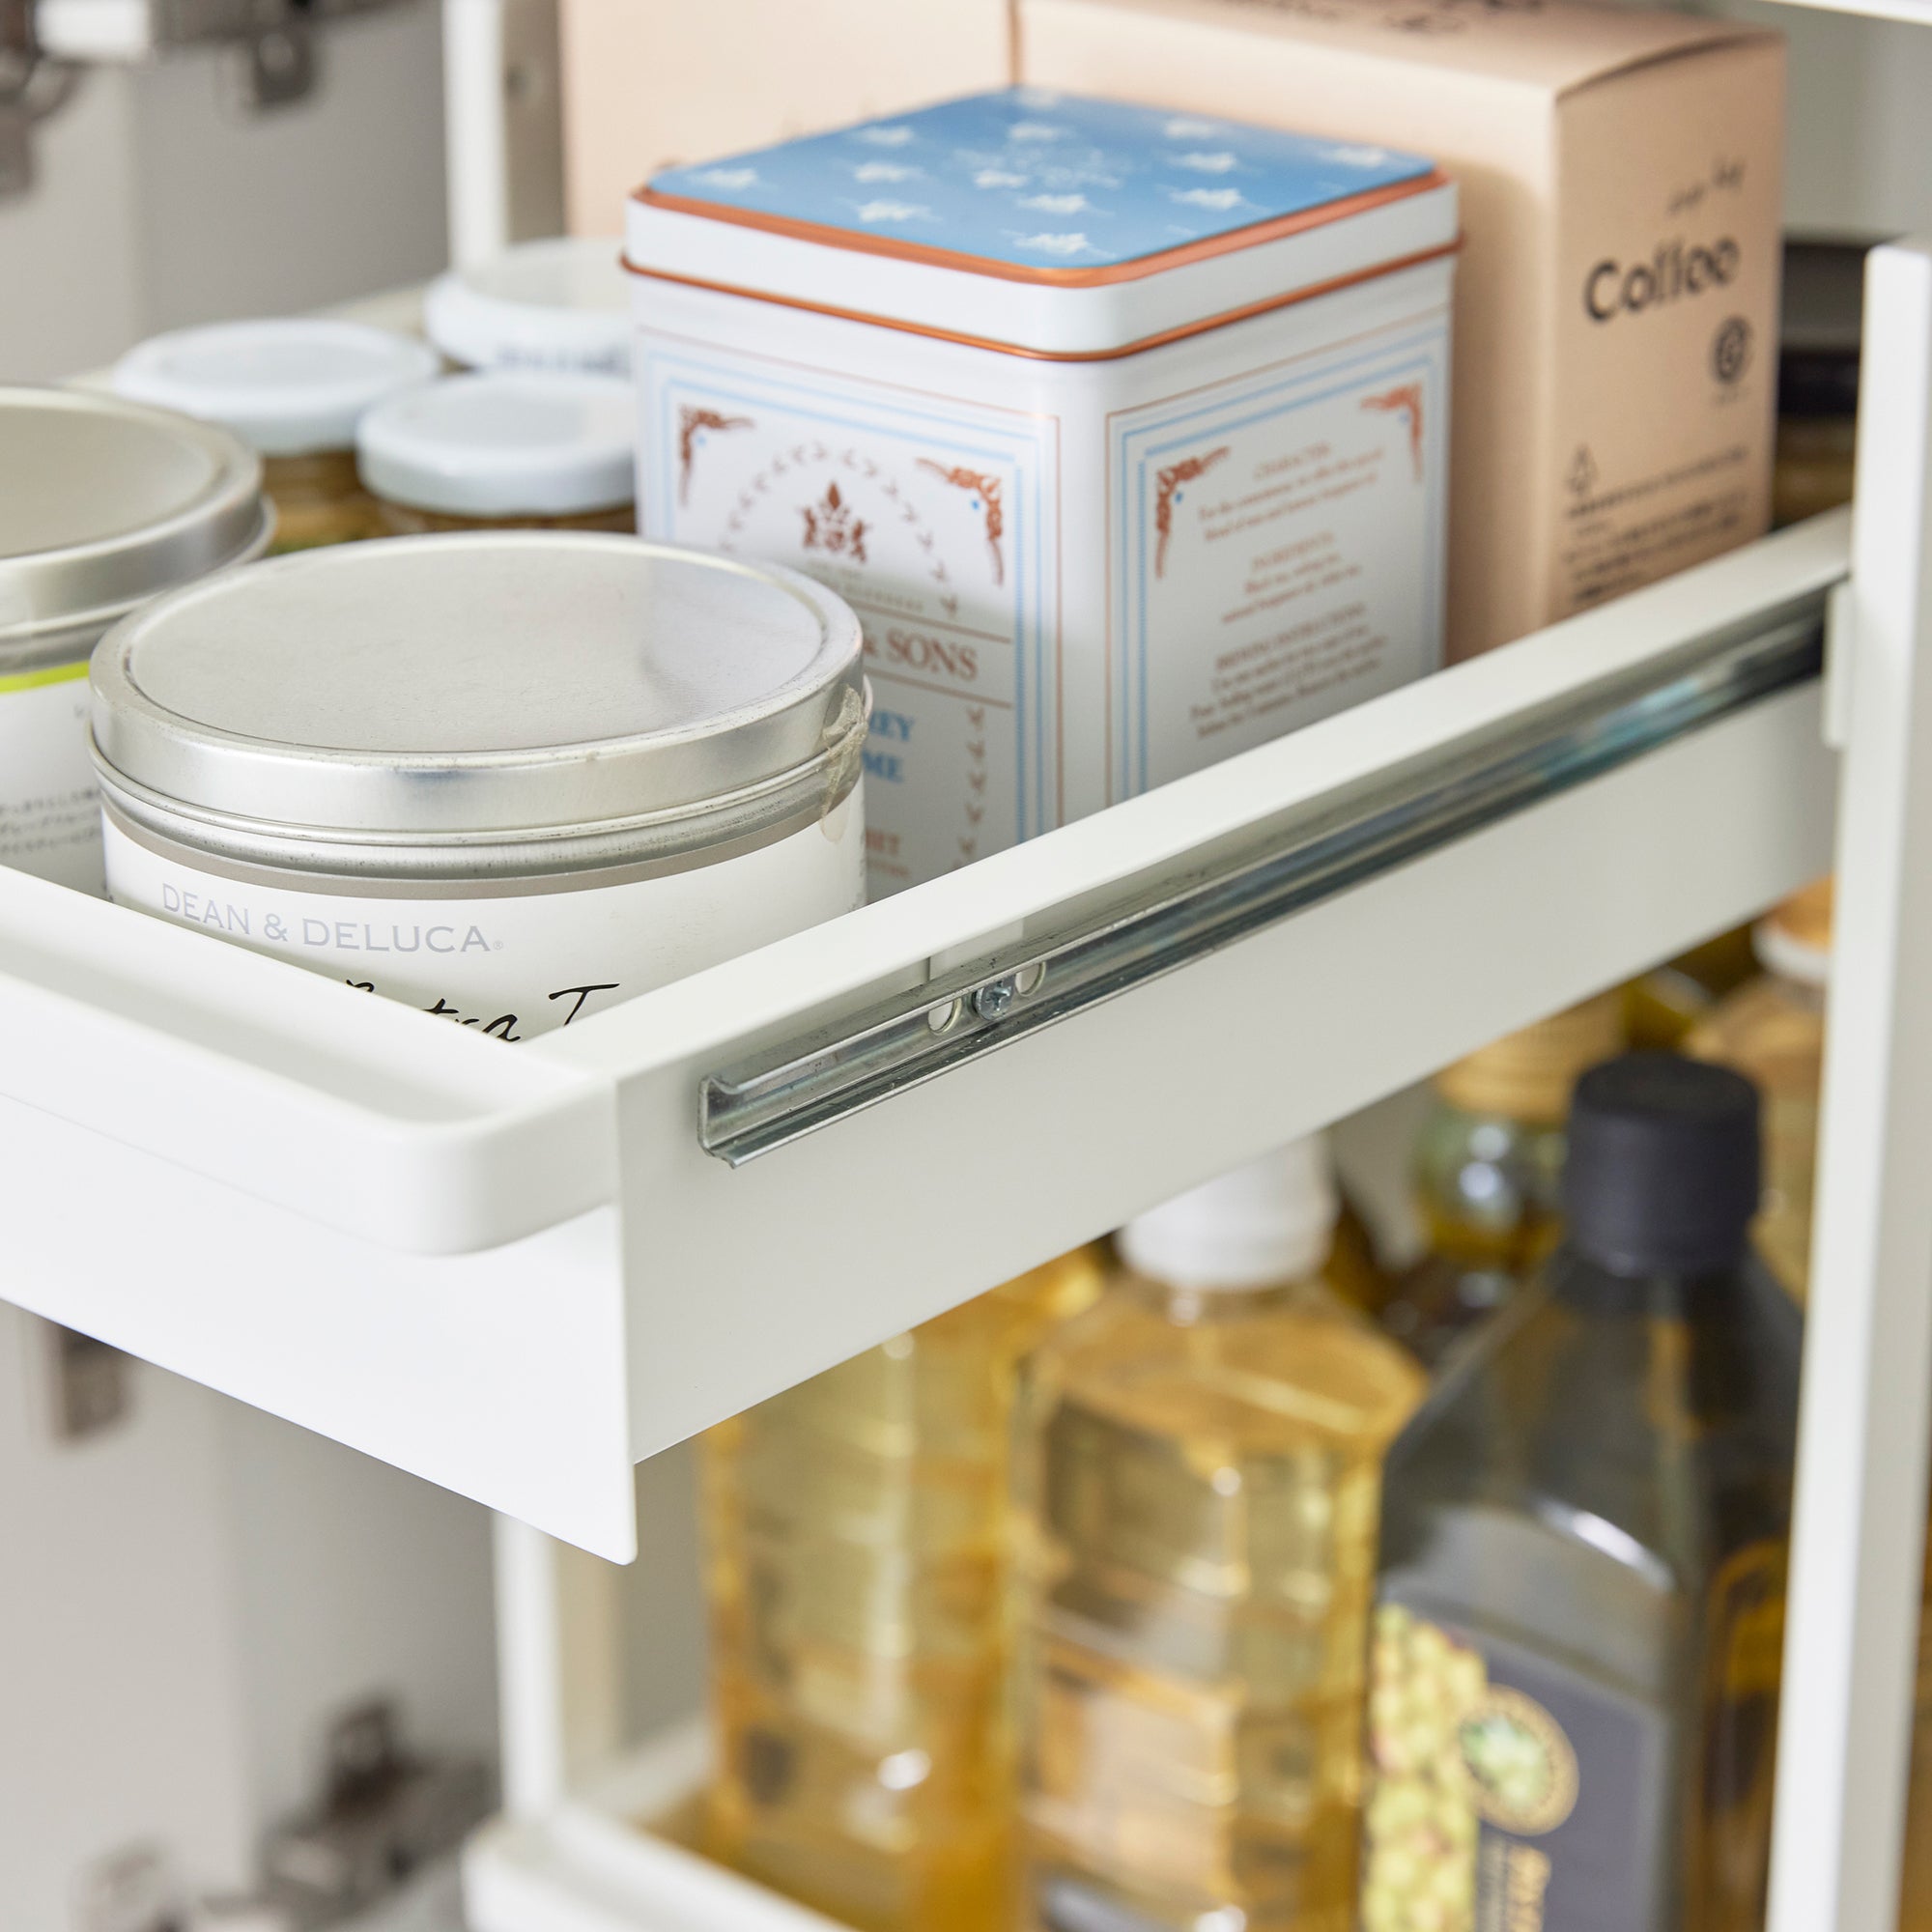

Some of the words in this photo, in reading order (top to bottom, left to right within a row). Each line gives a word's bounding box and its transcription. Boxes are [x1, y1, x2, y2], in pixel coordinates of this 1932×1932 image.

[886, 626, 979, 682] SONS
[161, 882, 251, 935] DEAN
[263, 913, 289, 942] &
